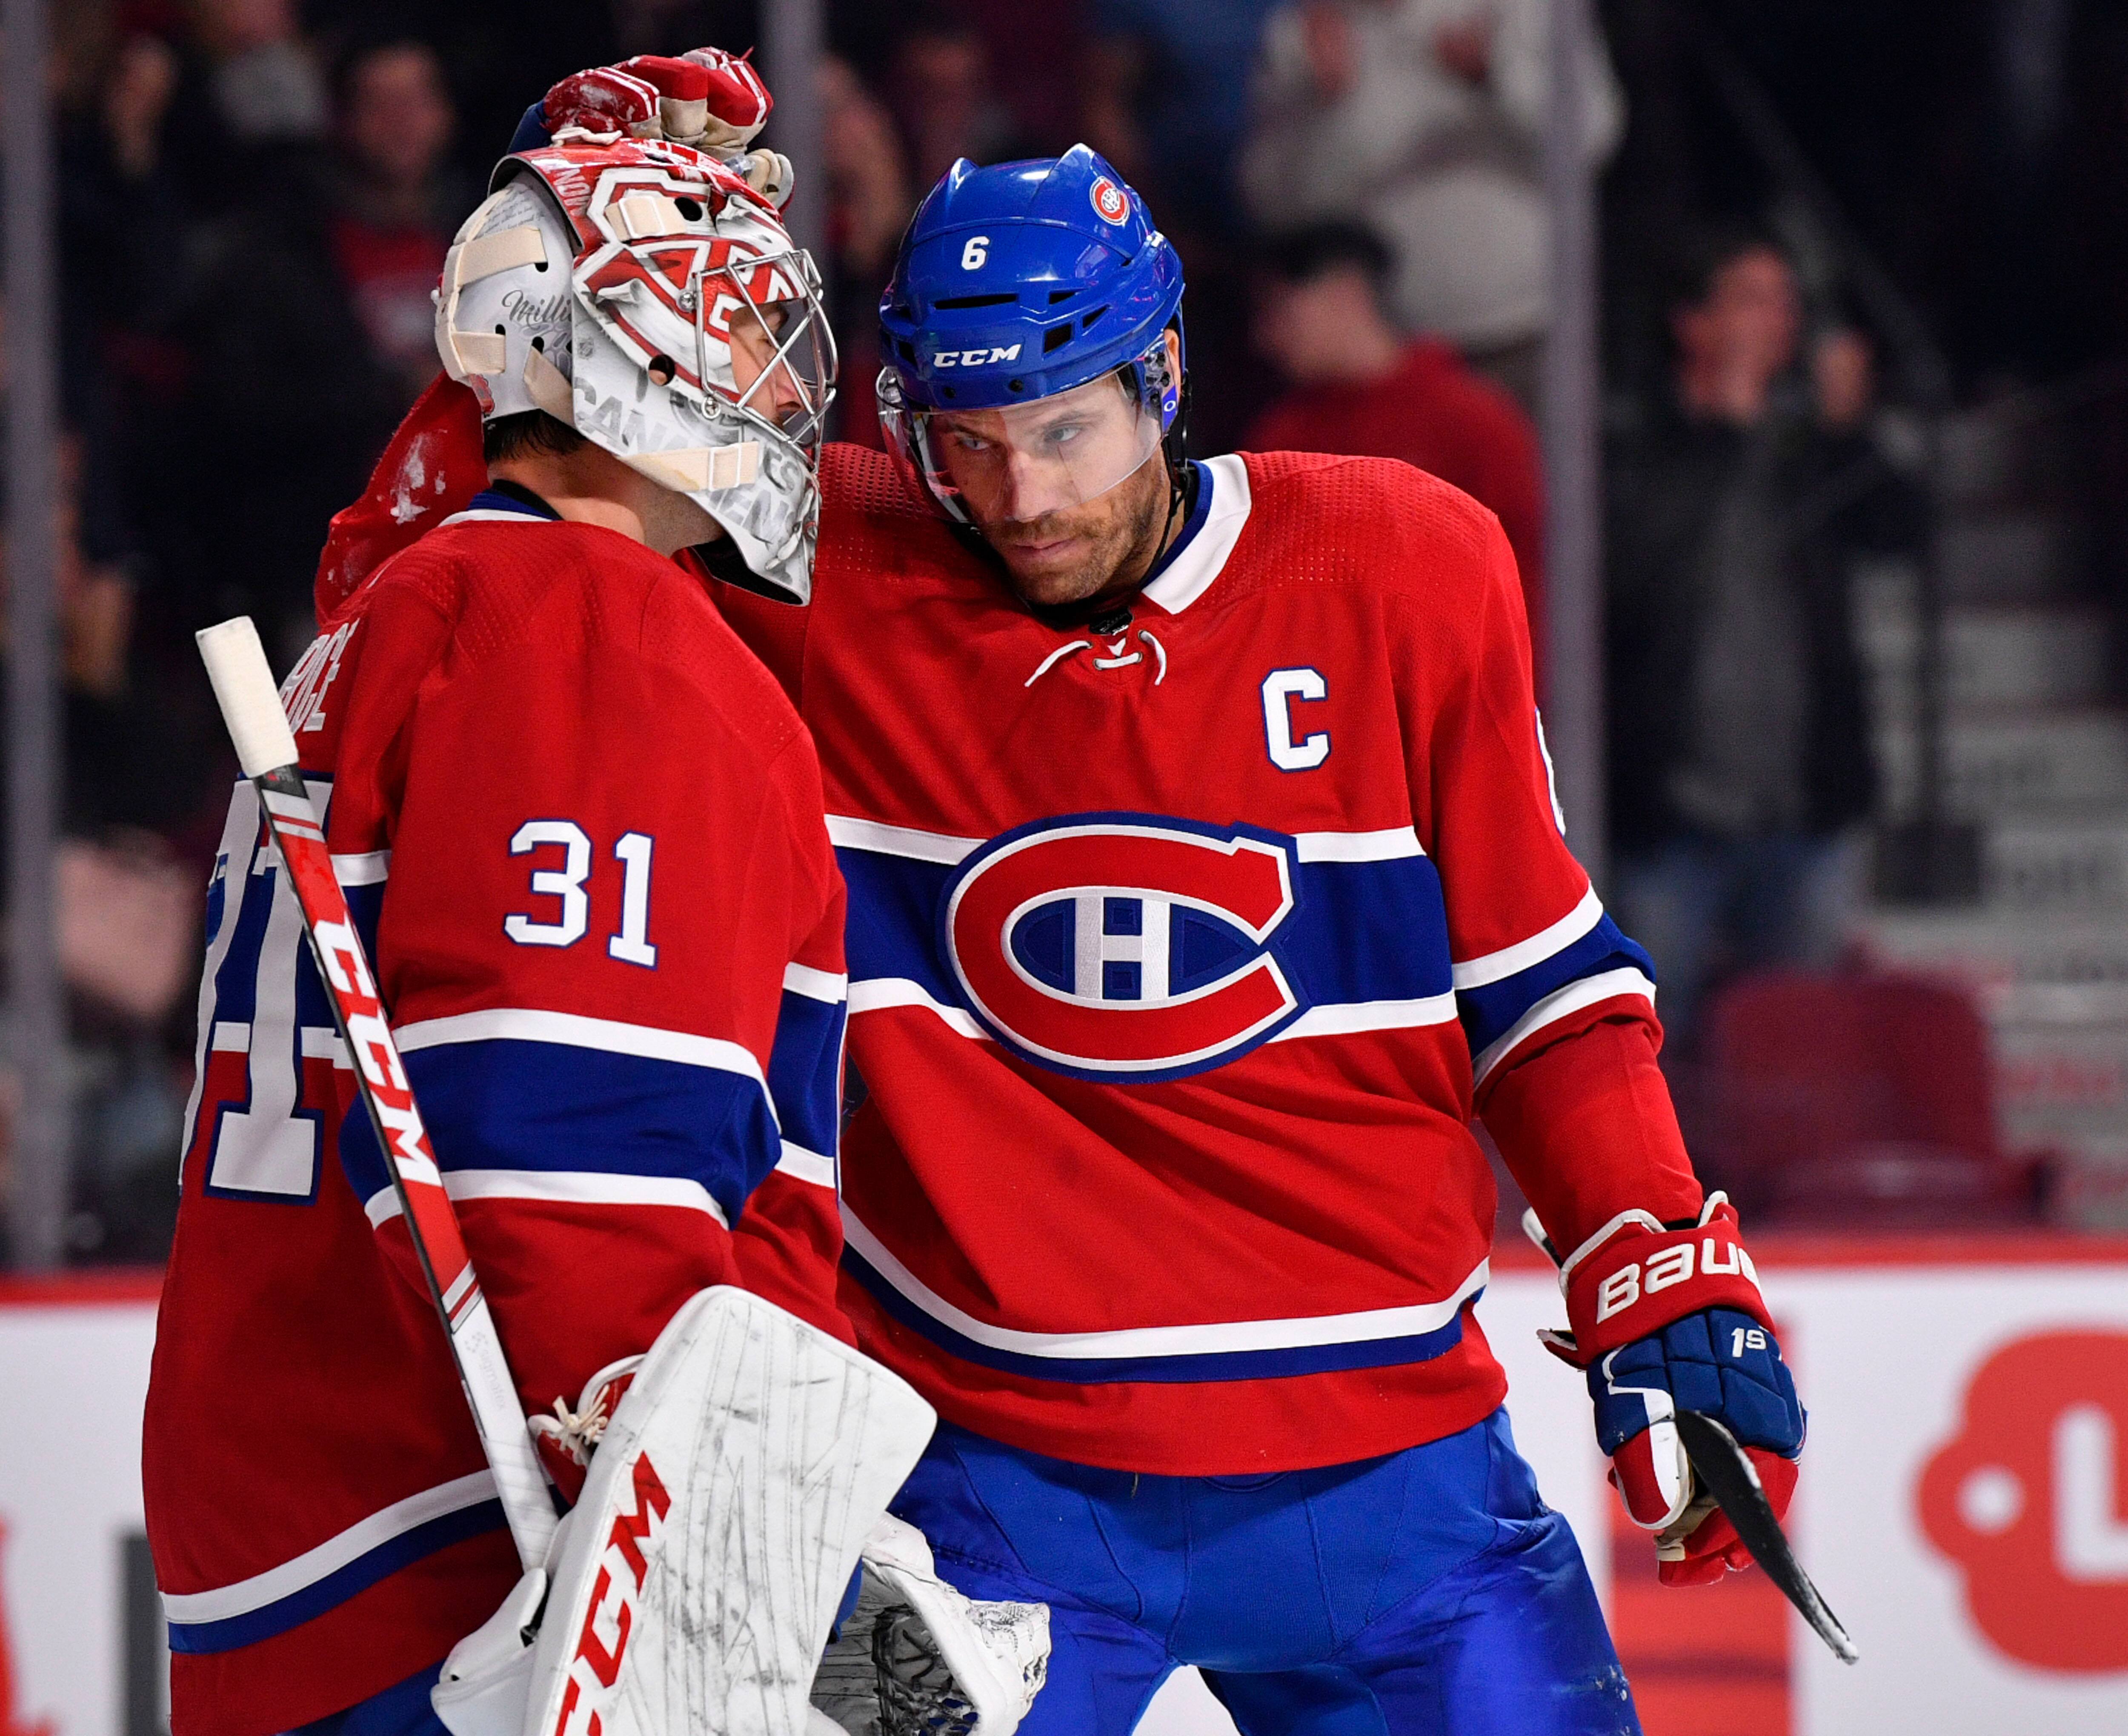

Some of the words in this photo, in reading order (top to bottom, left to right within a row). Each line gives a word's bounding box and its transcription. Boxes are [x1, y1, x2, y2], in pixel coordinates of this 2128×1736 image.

[961, 236, 990, 270] 6
[933, 344, 1021, 368] CCM
[279, 617, 360, 736] RICE
[1261, 667, 1329, 770] C
[504, 819, 656, 968] 31
[312, 918, 443, 1187] CCM
